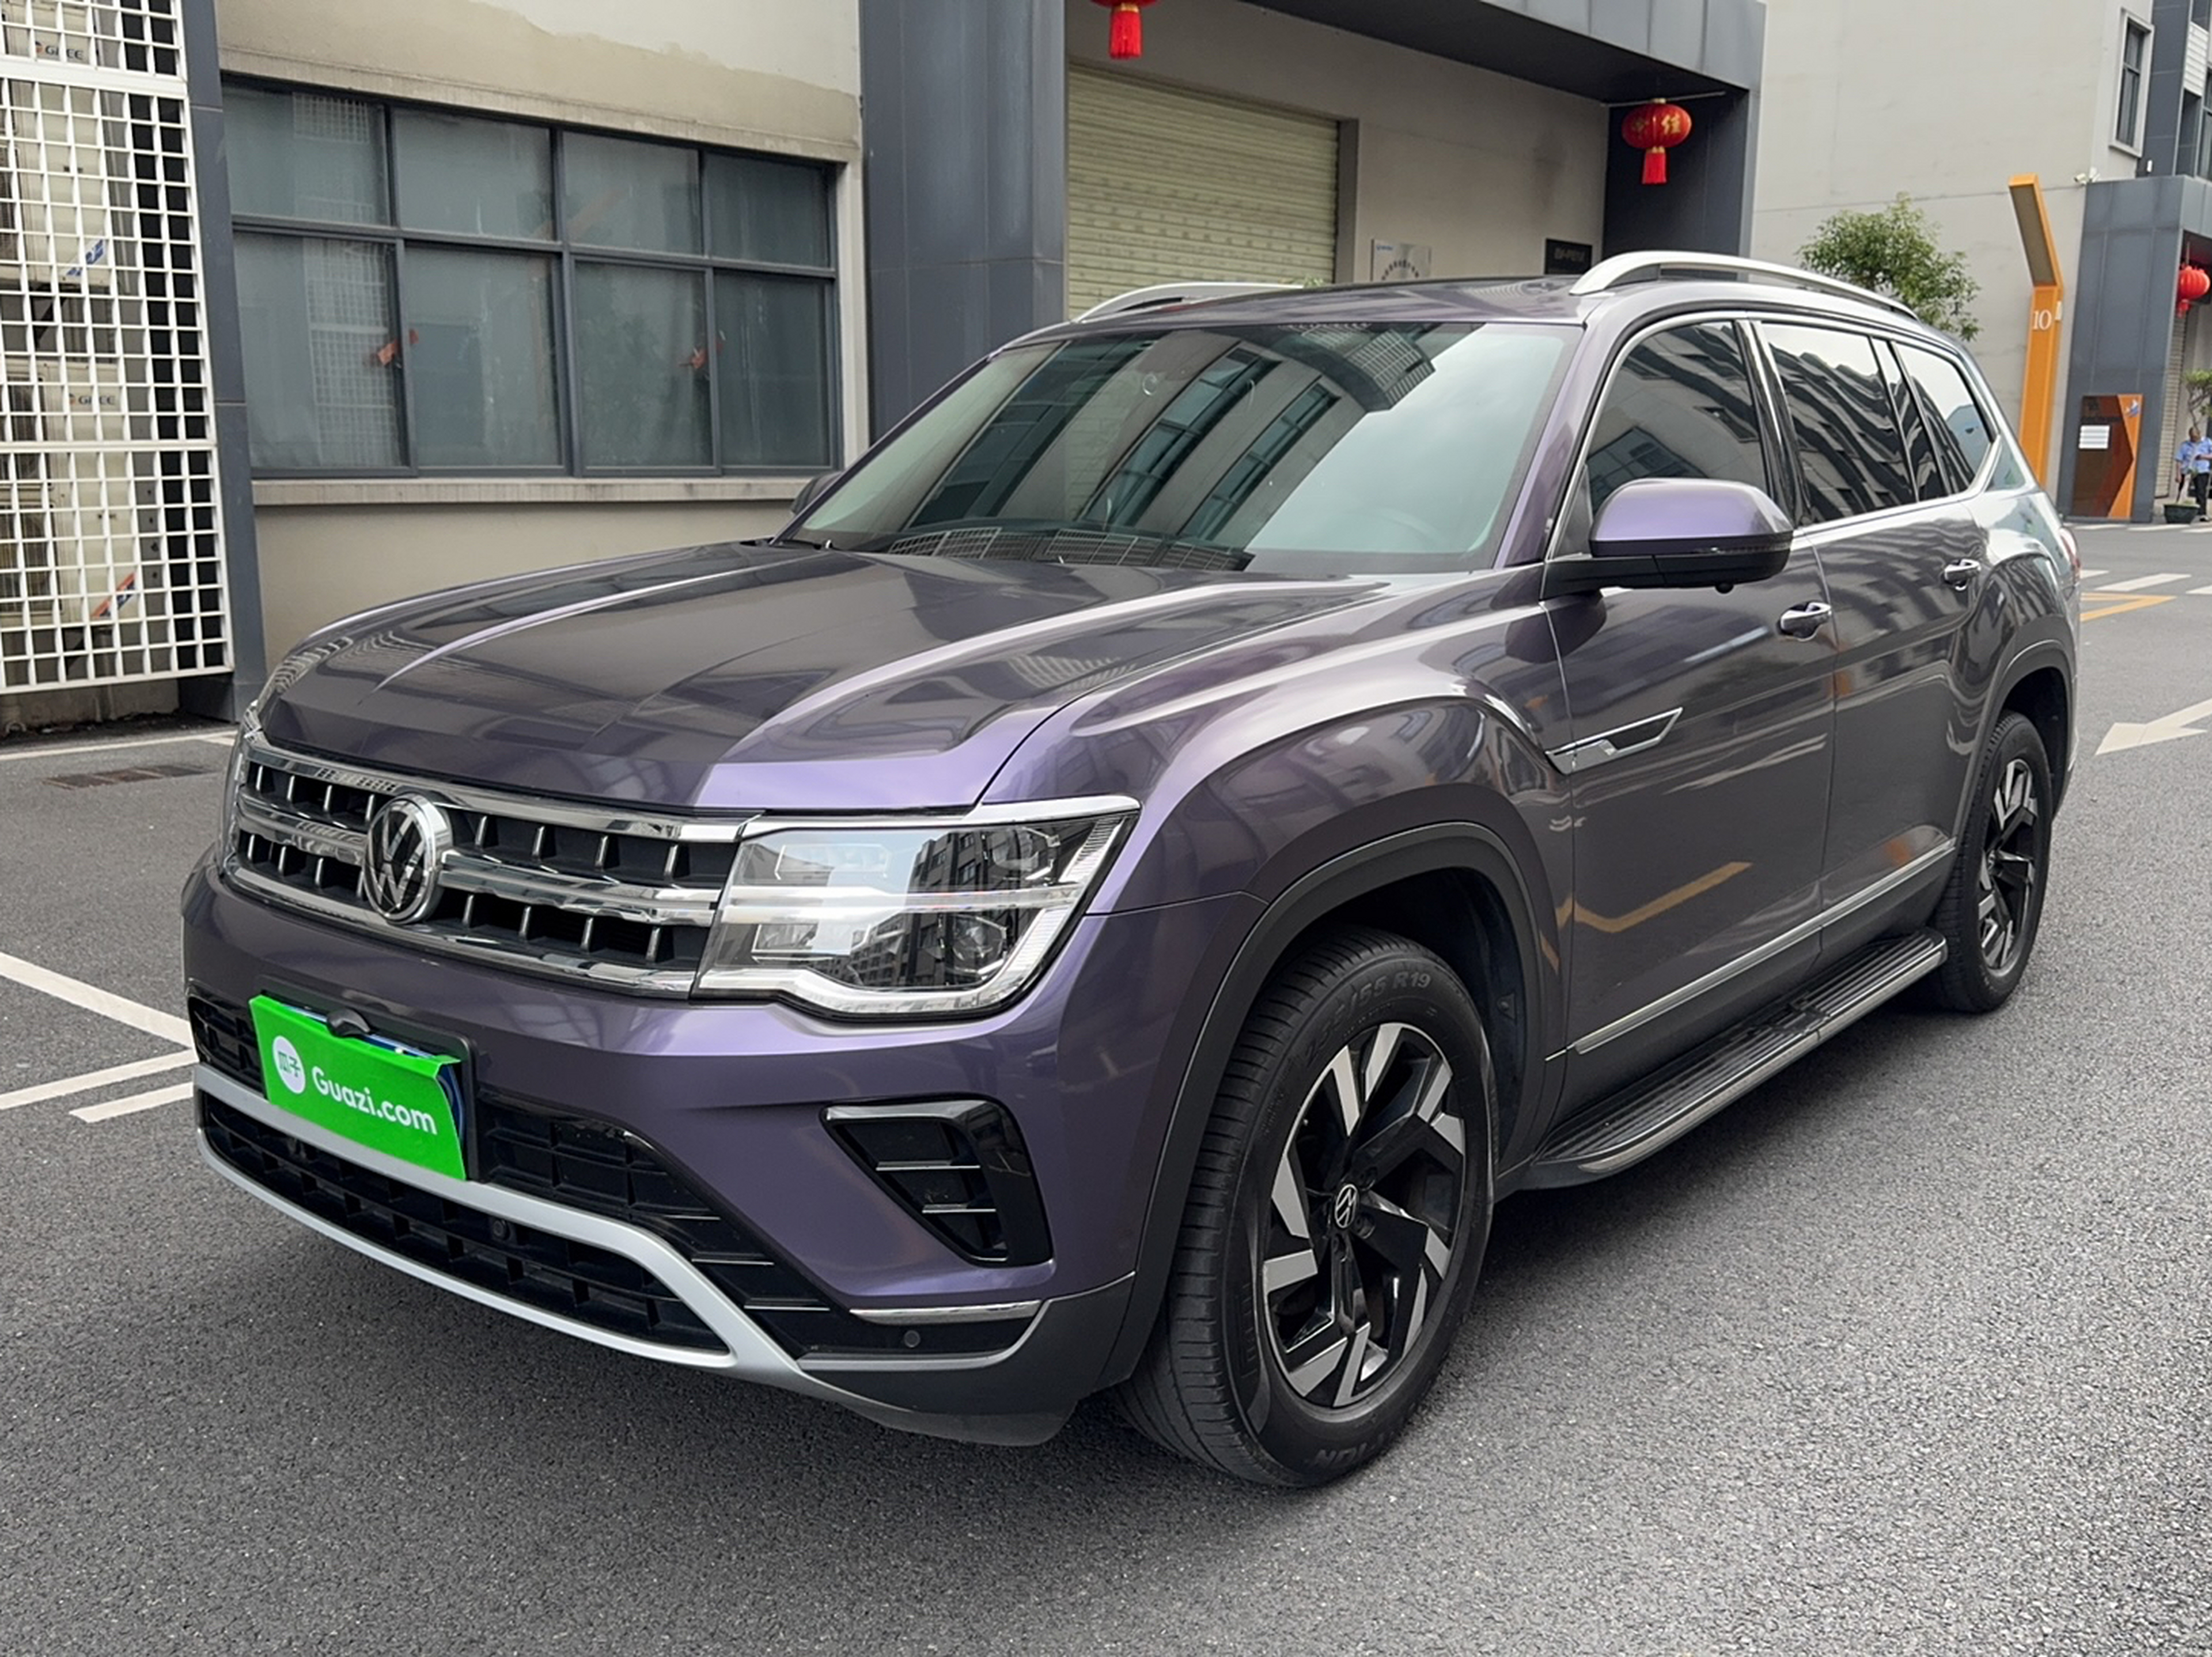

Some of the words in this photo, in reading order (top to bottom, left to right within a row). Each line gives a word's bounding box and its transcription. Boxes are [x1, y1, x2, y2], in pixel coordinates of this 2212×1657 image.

[2032, 309, 2052, 331] 10
[1392, 970, 1431, 989] R19
[277, 1050, 301, 1078] 瓜子
[311, 1066, 438, 1136] Guazi.com
